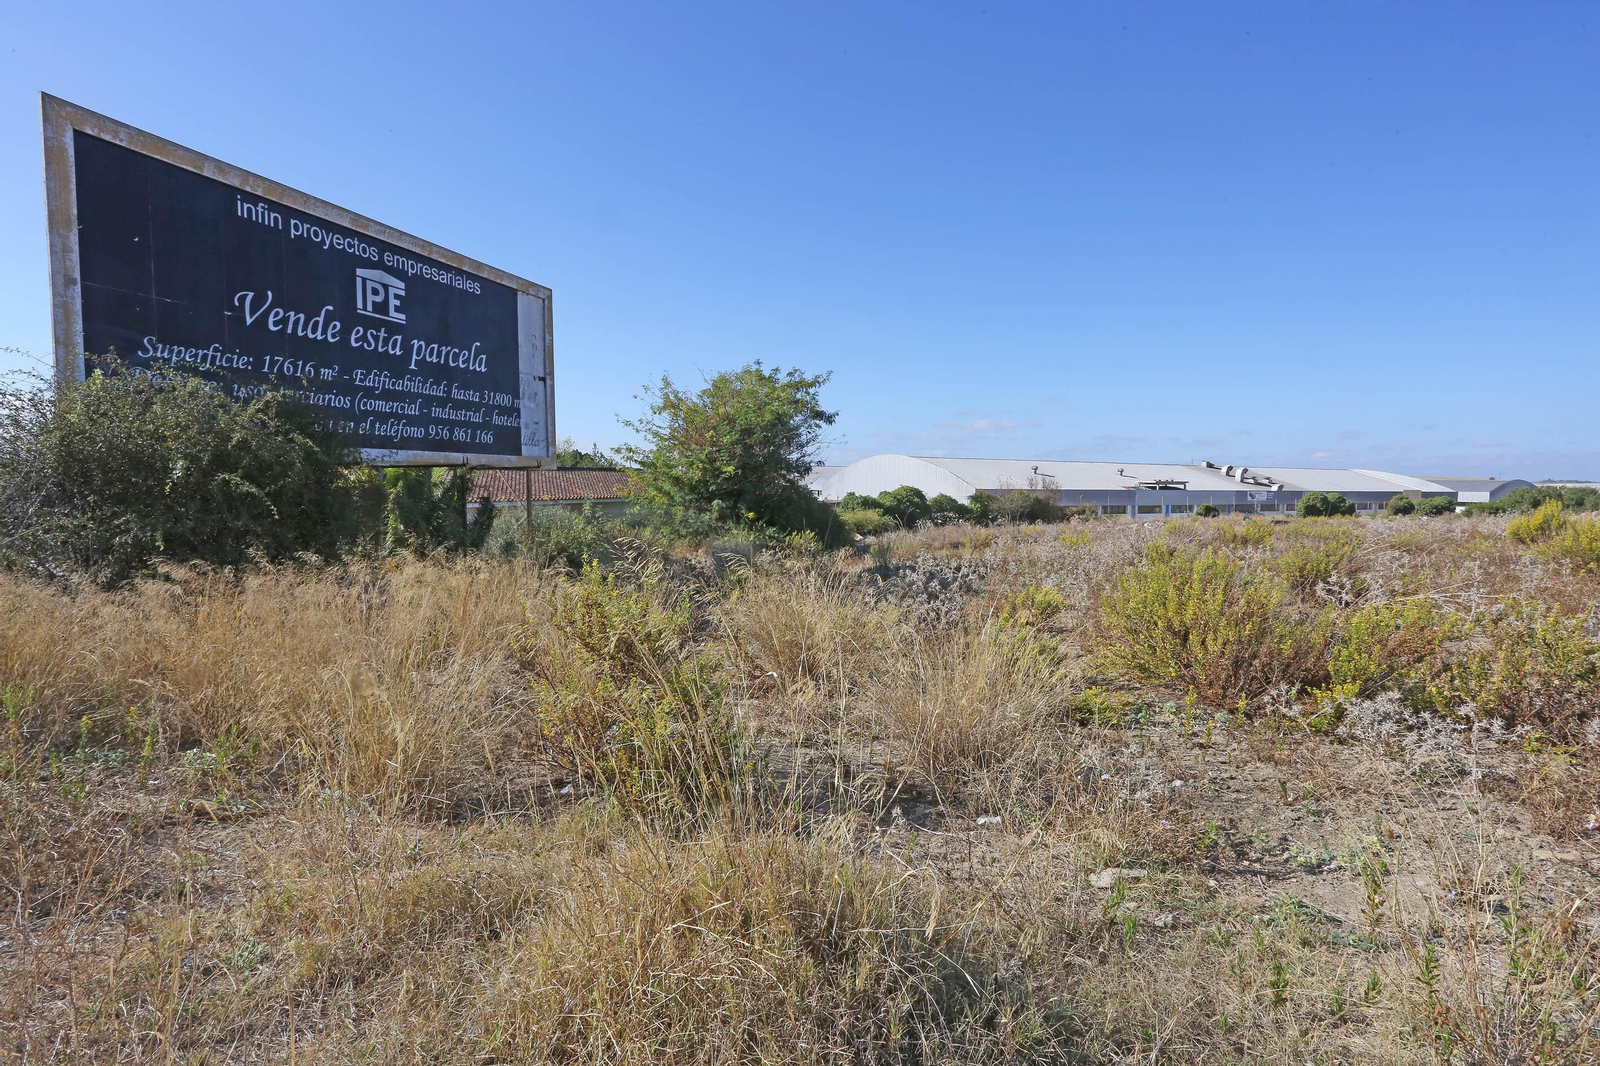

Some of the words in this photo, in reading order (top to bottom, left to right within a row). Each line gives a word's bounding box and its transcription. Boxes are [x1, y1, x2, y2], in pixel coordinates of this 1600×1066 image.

[236, 194, 283, 230] infin
[289, 218, 379, 261] proyectos
[383, 251, 481, 295] empresariales
[356, 276, 406, 321] IPE
[234, 290, 341, 343] Vende
[350, 326, 404, 356] esta
[408, 339, 488, 373] parcela
[137, 335, 254, 371] Superficie:
[261, 354, 316, 379] 17616
[352, 369, 448, 398] Edificabilidad:
[451, 383, 480, 402] hasta
[482, 390, 512, 407] 31800
[355, 391, 422, 416] (comercial
[431, 402, 485, 423] industrial
[359, 416, 374, 435] el
[375, 418, 425, 442] teléfono
[428, 424, 451, 440] 956
[452, 426, 471, 442] 861
[475, 429, 494, 444] 166
